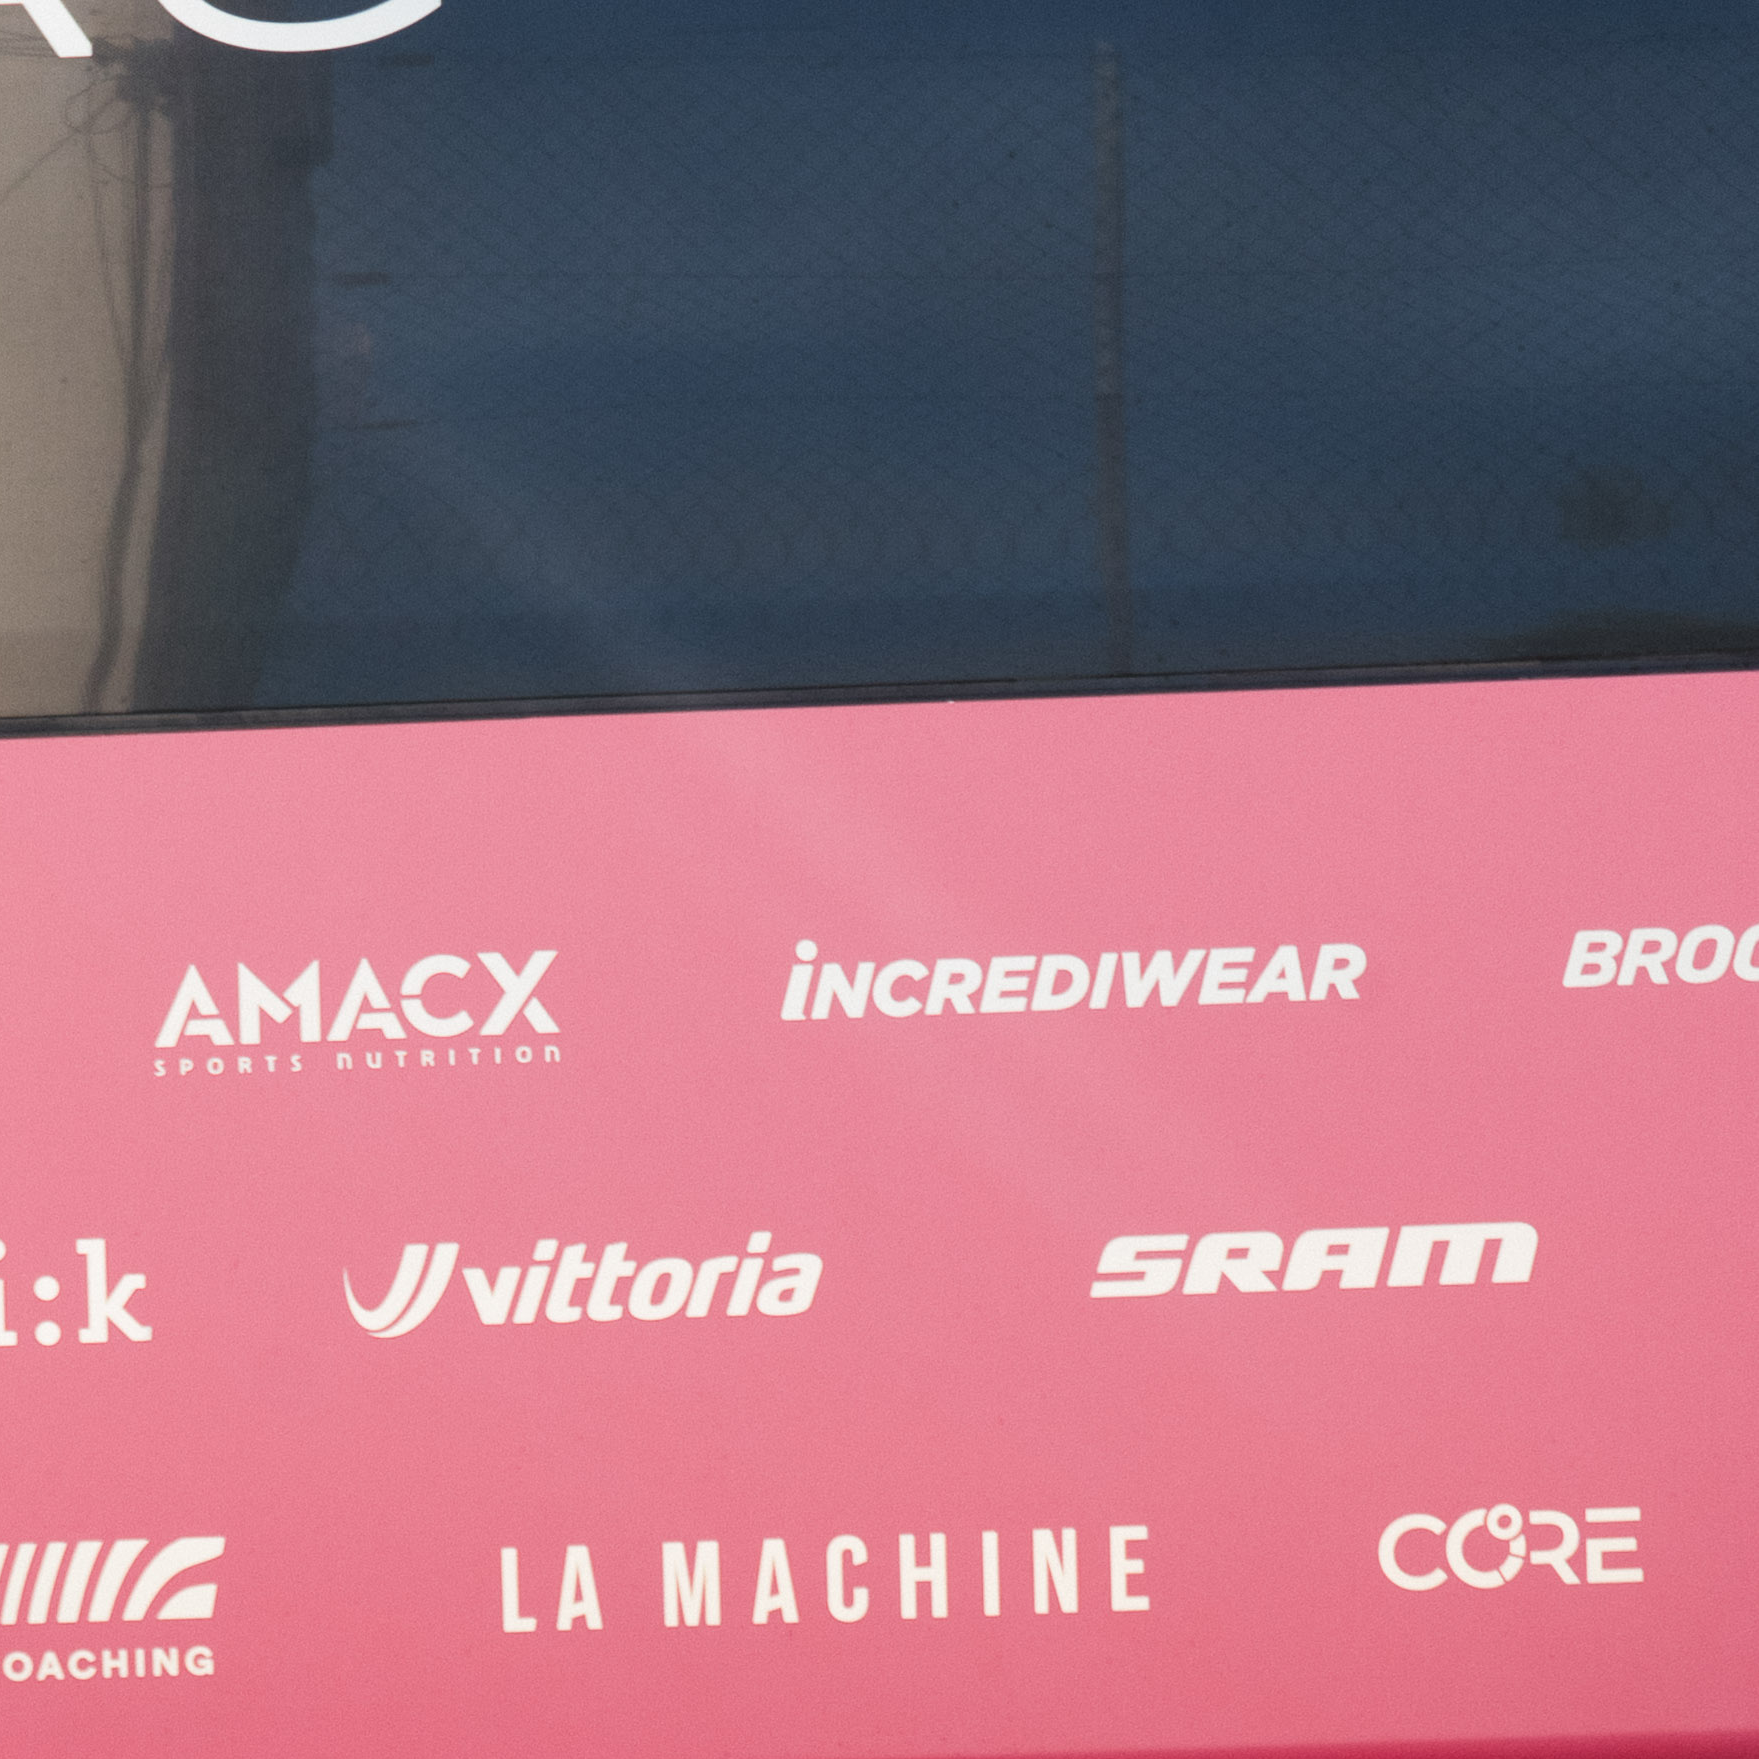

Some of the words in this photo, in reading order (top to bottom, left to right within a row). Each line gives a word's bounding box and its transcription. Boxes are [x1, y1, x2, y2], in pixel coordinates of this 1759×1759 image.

[154, 949, 561, 1048] AMACX
[153, 1054, 303, 1077] SPORTS
[461, 1230, 824, 1326] vittoria
[1091, 1221, 1539, 1298] SRAM
[500, 1544, 603, 1632] LA
[661, 1525, 1151, 1628] MACHINE
[1378, 1503, 1644, 1591] CORE
